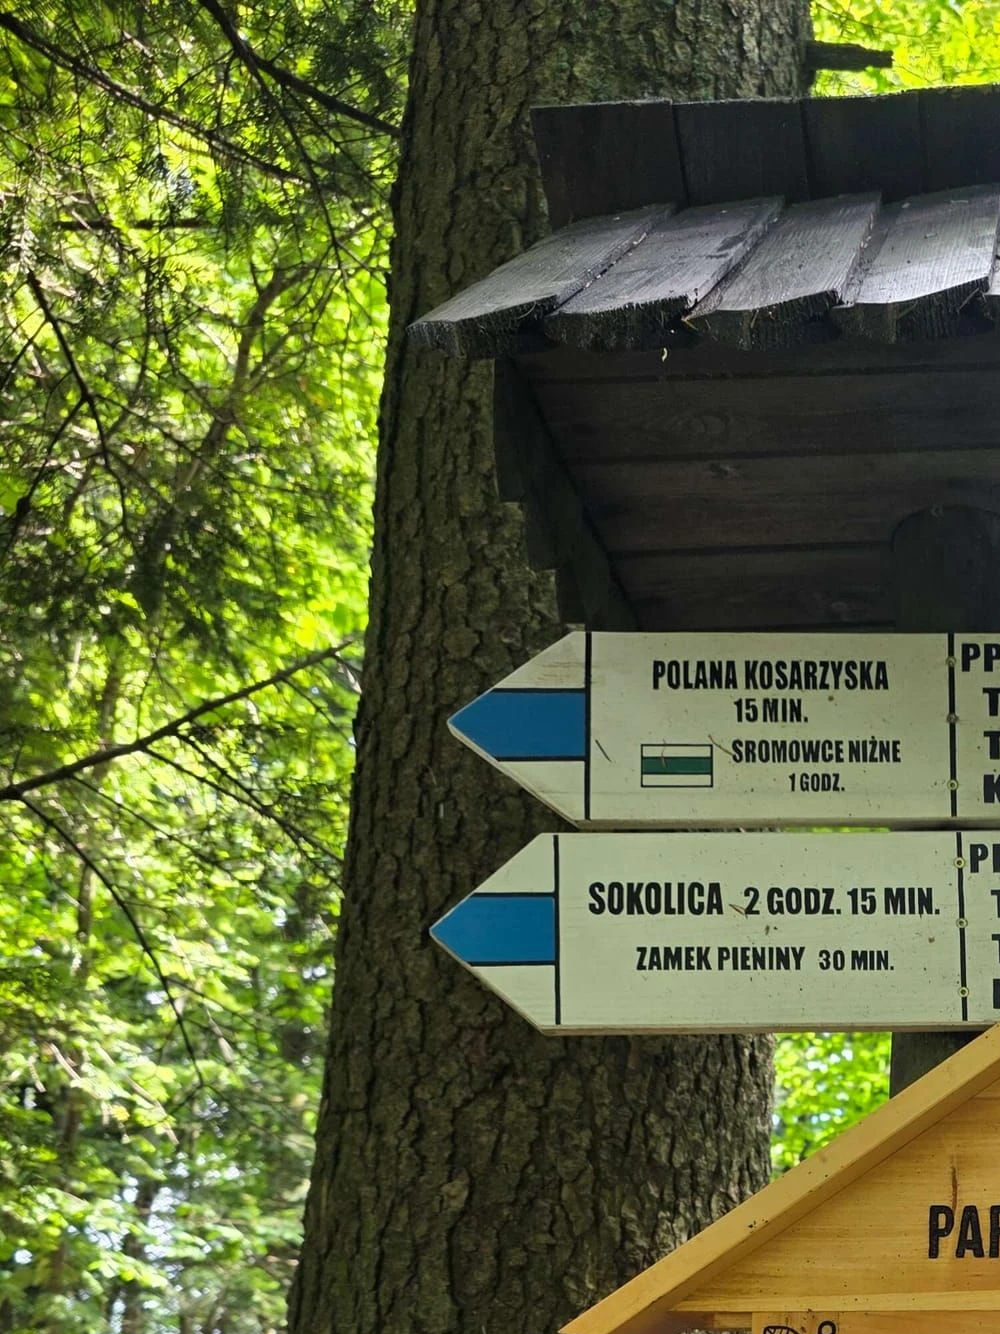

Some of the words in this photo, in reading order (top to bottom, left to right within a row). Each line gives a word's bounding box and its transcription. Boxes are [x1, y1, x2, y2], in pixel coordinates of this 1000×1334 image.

[653, 660, 737, 689] POLANA
[745, 661, 888, 690] KOSARZYSKA
[734, 698, 758, 722] 15
[763, 698, 808, 722] MIN.
[732, 739, 844, 763] SROMOWCE
[849, 736, 901, 762] NIŻNE
[789, 773, 795, 792] 1
[800, 773, 845, 792] GODZ.
[589, 882, 723, 915] SOKOLICA
[744, 887, 760, 915] 2
[767, 888, 841, 915] GODZ.
[850, 888, 876, 914] 15
[885, 888, 939, 917] MIN.
[637, 947, 712, 970] ZAMEK
[718, 947, 805, 970] PIENINY
[819, 950, 845, 970] 30
[851, 950, 894, 970] MIN.
